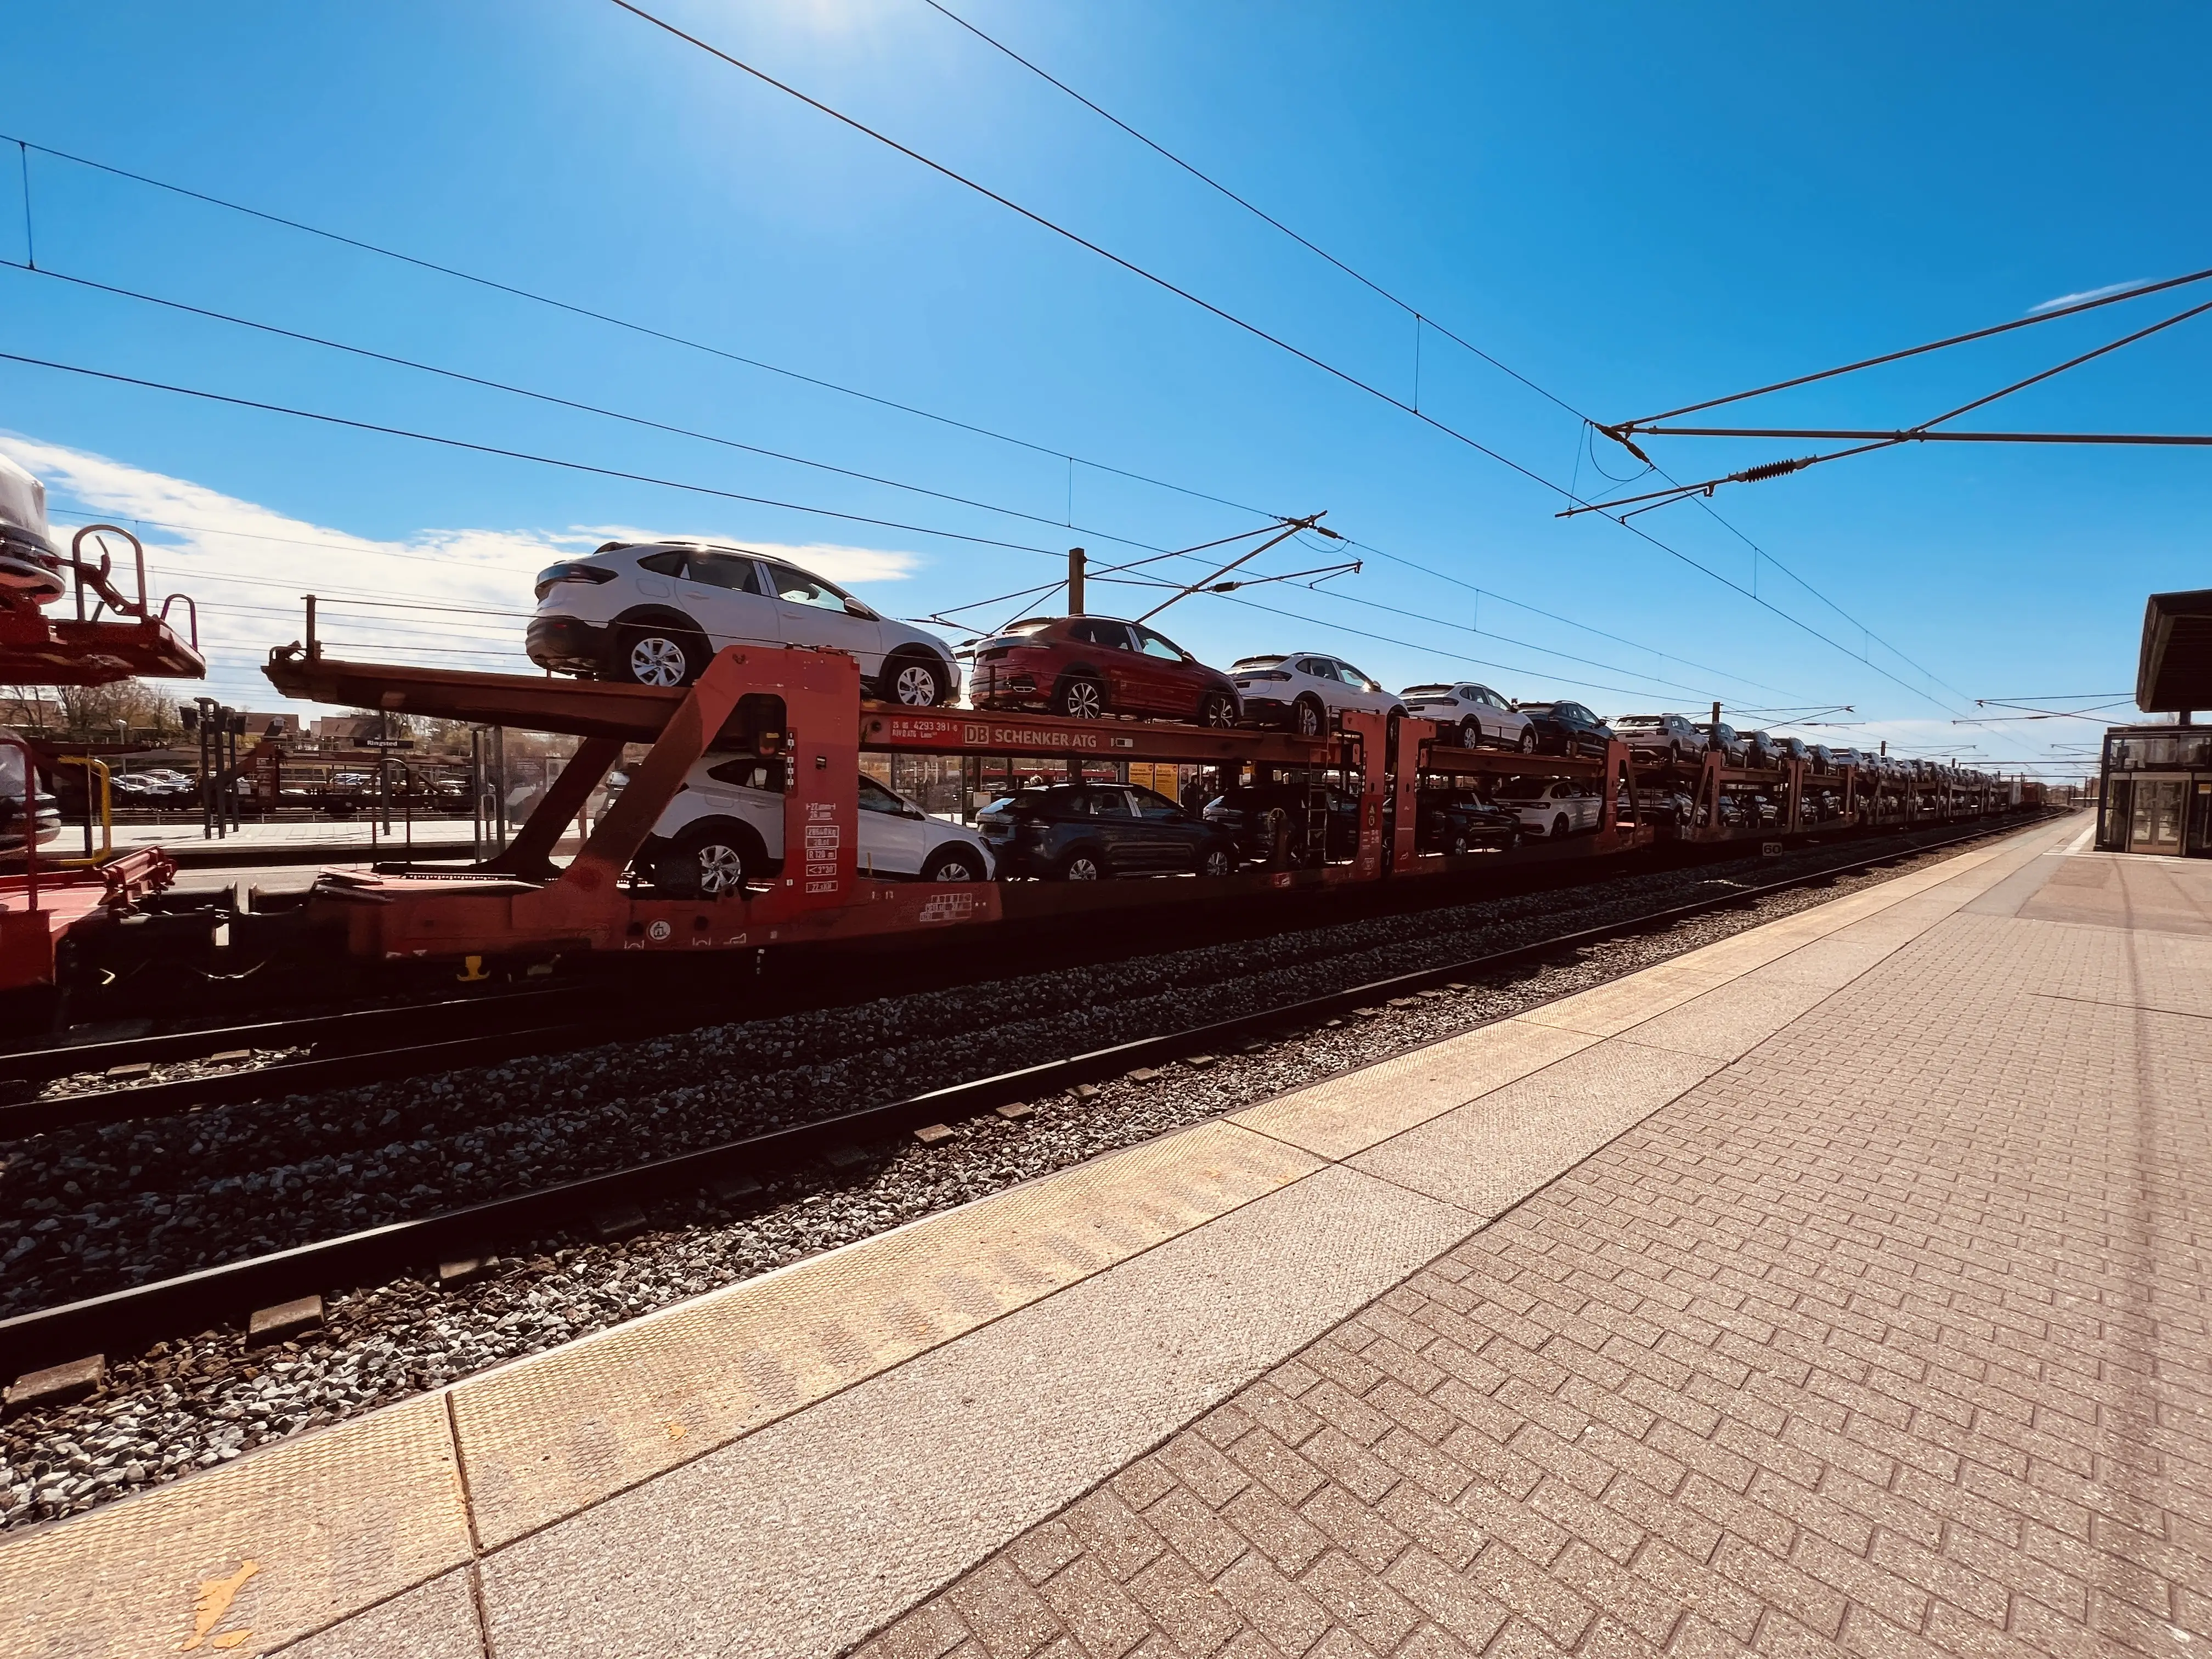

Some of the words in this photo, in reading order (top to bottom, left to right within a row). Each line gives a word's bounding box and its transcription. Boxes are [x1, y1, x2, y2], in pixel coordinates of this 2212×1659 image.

[913, 720, 934, 730] 4293
[936, 721, 950, 731] 381
[965, 725, 989, 744] DB
[995, 729, 1069, 746] SCHENKER
[1071, 734, 1097, 747] ATG
[809, 850, 814, 859] R
[1764, 845, 1781, 854] 60
